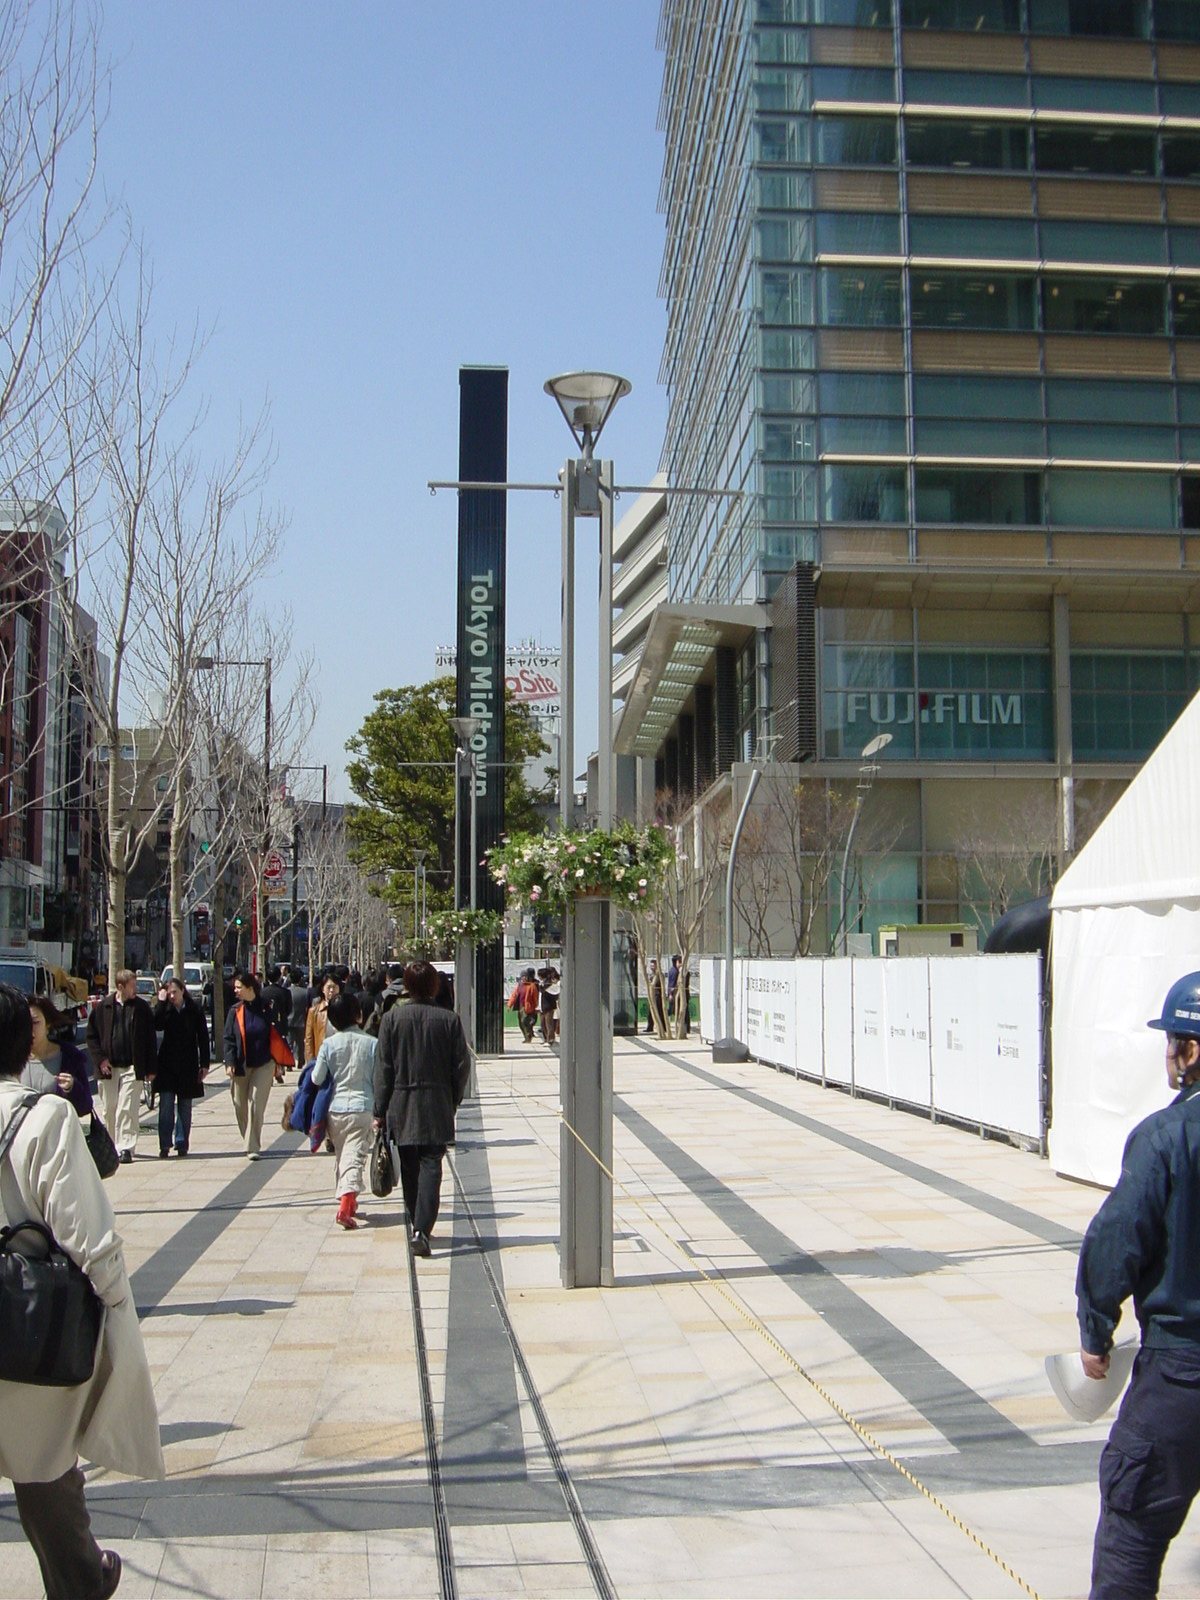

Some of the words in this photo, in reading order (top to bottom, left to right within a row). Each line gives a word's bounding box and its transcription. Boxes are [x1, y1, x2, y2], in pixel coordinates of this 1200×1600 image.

[465, 569, 494, 657] Tokyo
[470, 666, 493, 797] Midtown
[847, 693, 1022, 724] FUJIFILM
